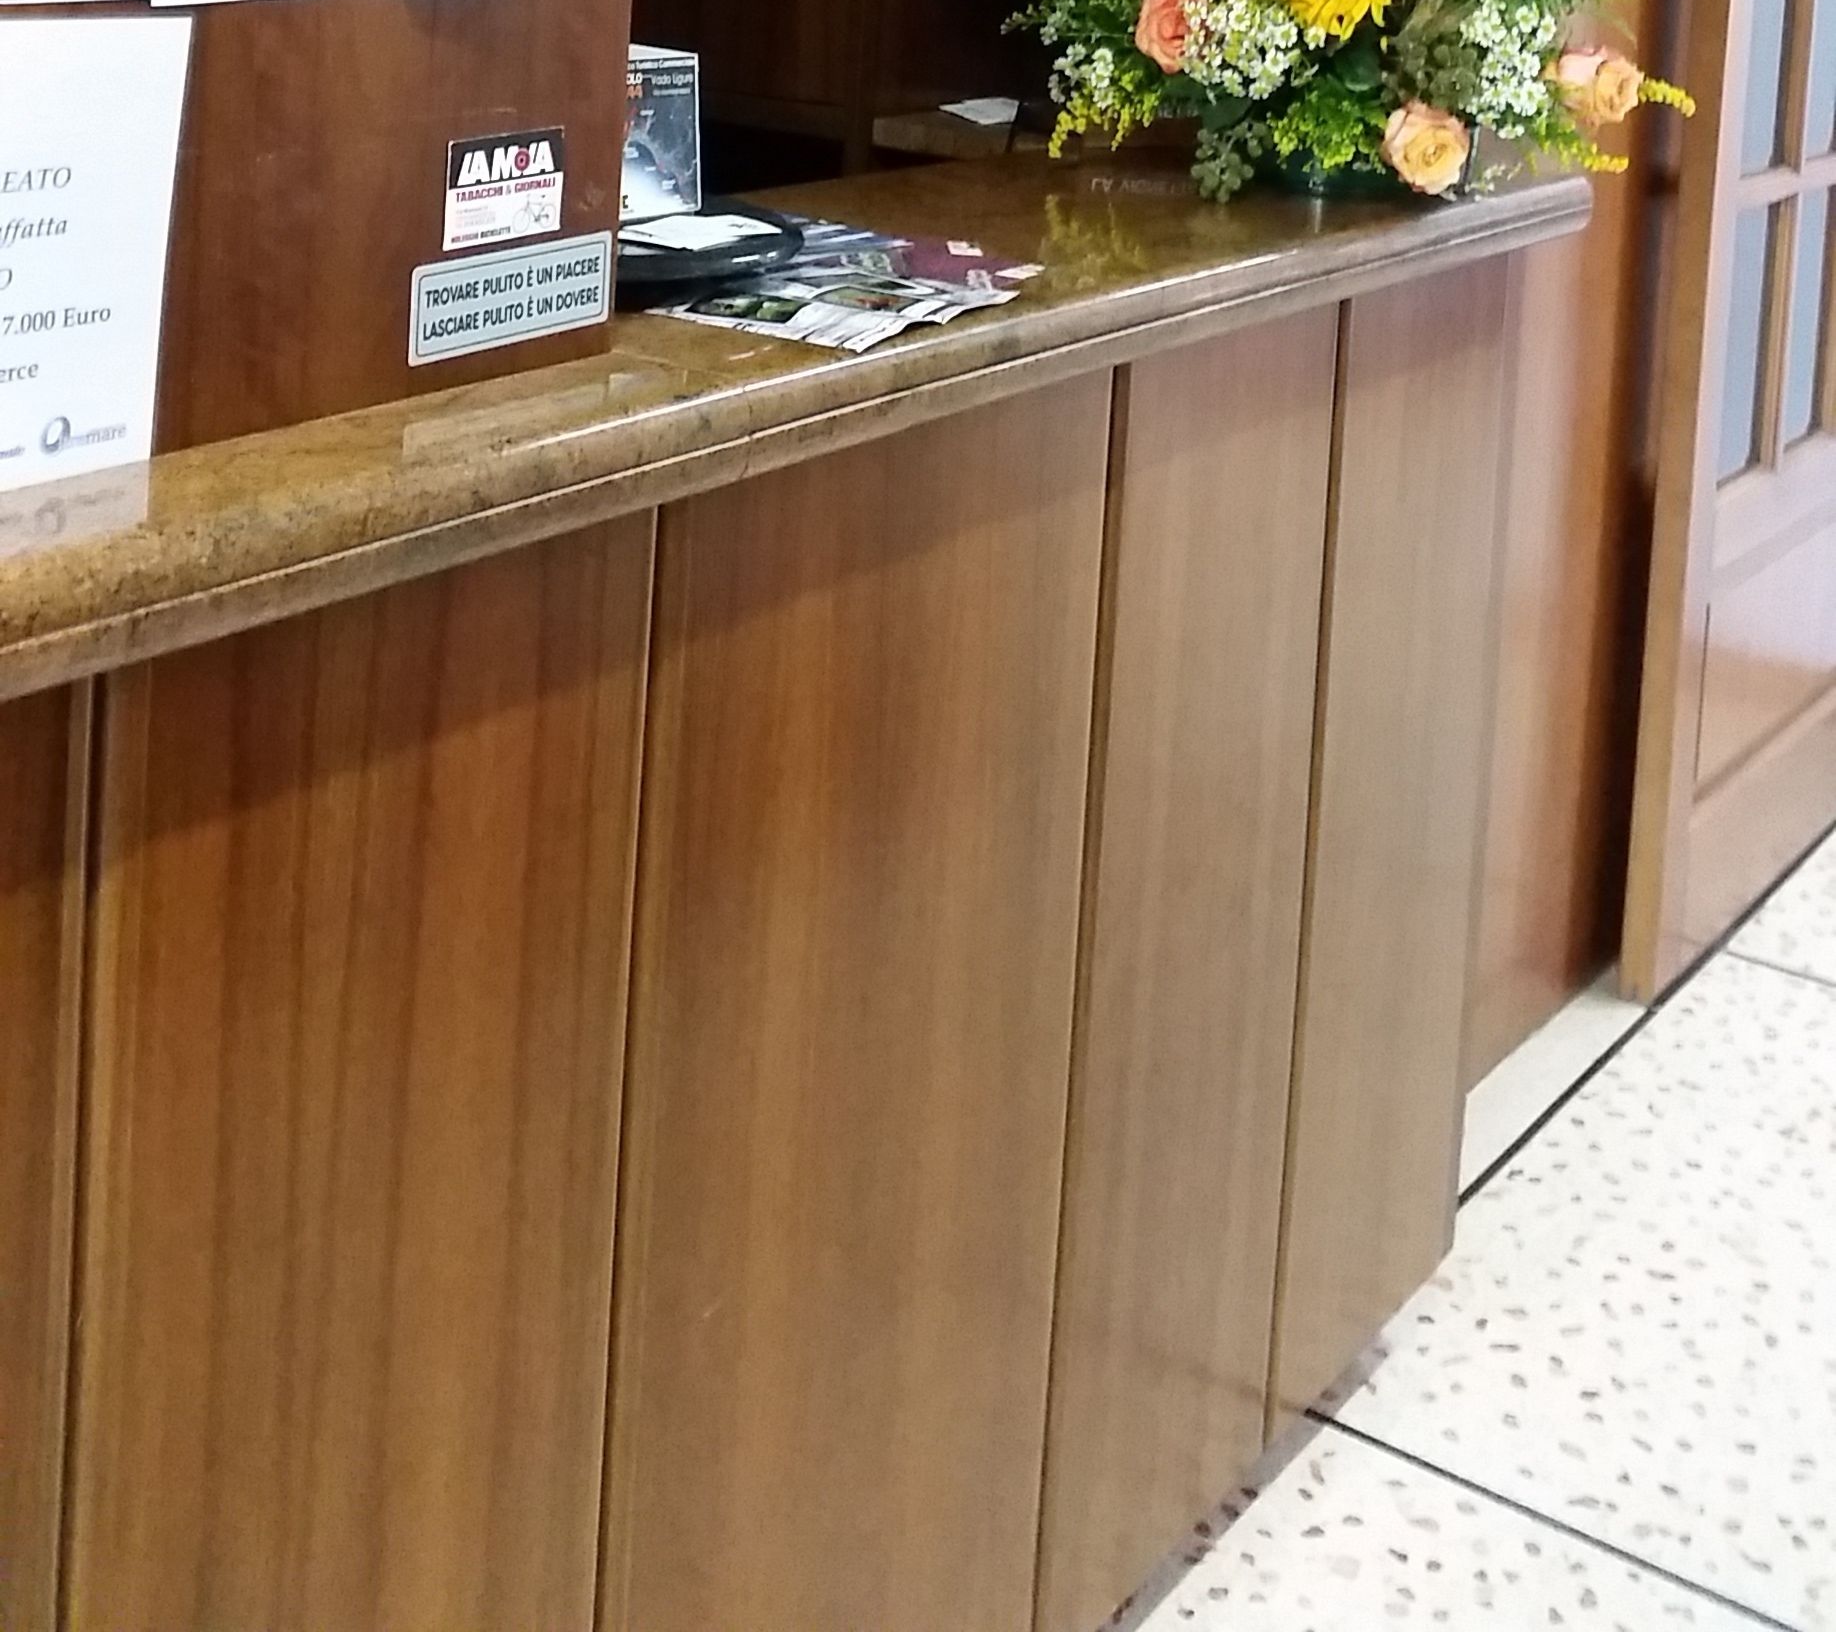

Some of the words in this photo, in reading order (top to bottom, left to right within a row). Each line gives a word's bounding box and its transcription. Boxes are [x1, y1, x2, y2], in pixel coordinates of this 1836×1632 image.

[455, 186, 504, 203] TABACCHI
[0, 217, 68, 248] ffatta
[425, 281, 480, 309] TROVARE
[482, 271, 524, 297] PULITO
[526, 265, 534, 285] È
[536, 266, 553, 285] UN
[555, 255, 601, 280] PIACERE
[62, 307, 112, 329] Euro
[423, 311, 480, 342] LASCIARE
[482, 302, 524, 328] PULITO
[526, 295, 534, 316] È
[536, 295, 553, 315] UN
[555, 285, 600, 309] DOVERE
